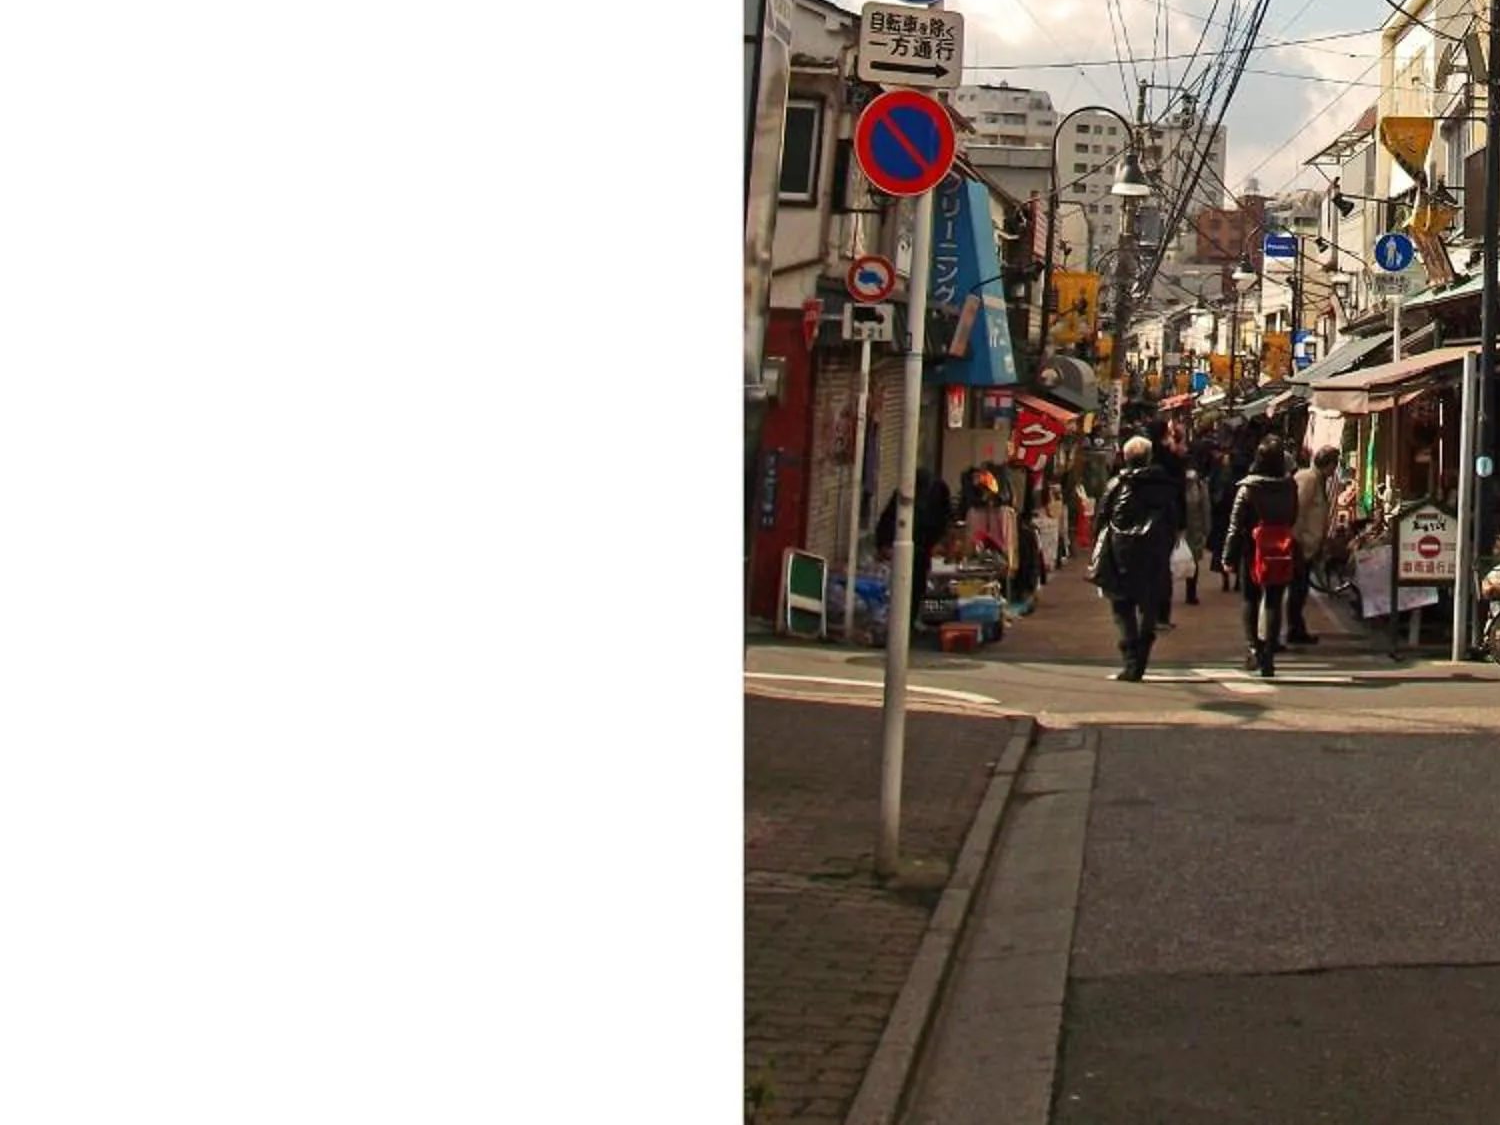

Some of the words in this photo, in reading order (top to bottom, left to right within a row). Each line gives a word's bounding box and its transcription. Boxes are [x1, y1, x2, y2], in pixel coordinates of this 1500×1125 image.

[869, 11, 955, 40] 自転車を除く
[868, 37, 955, 61] 一方通行
